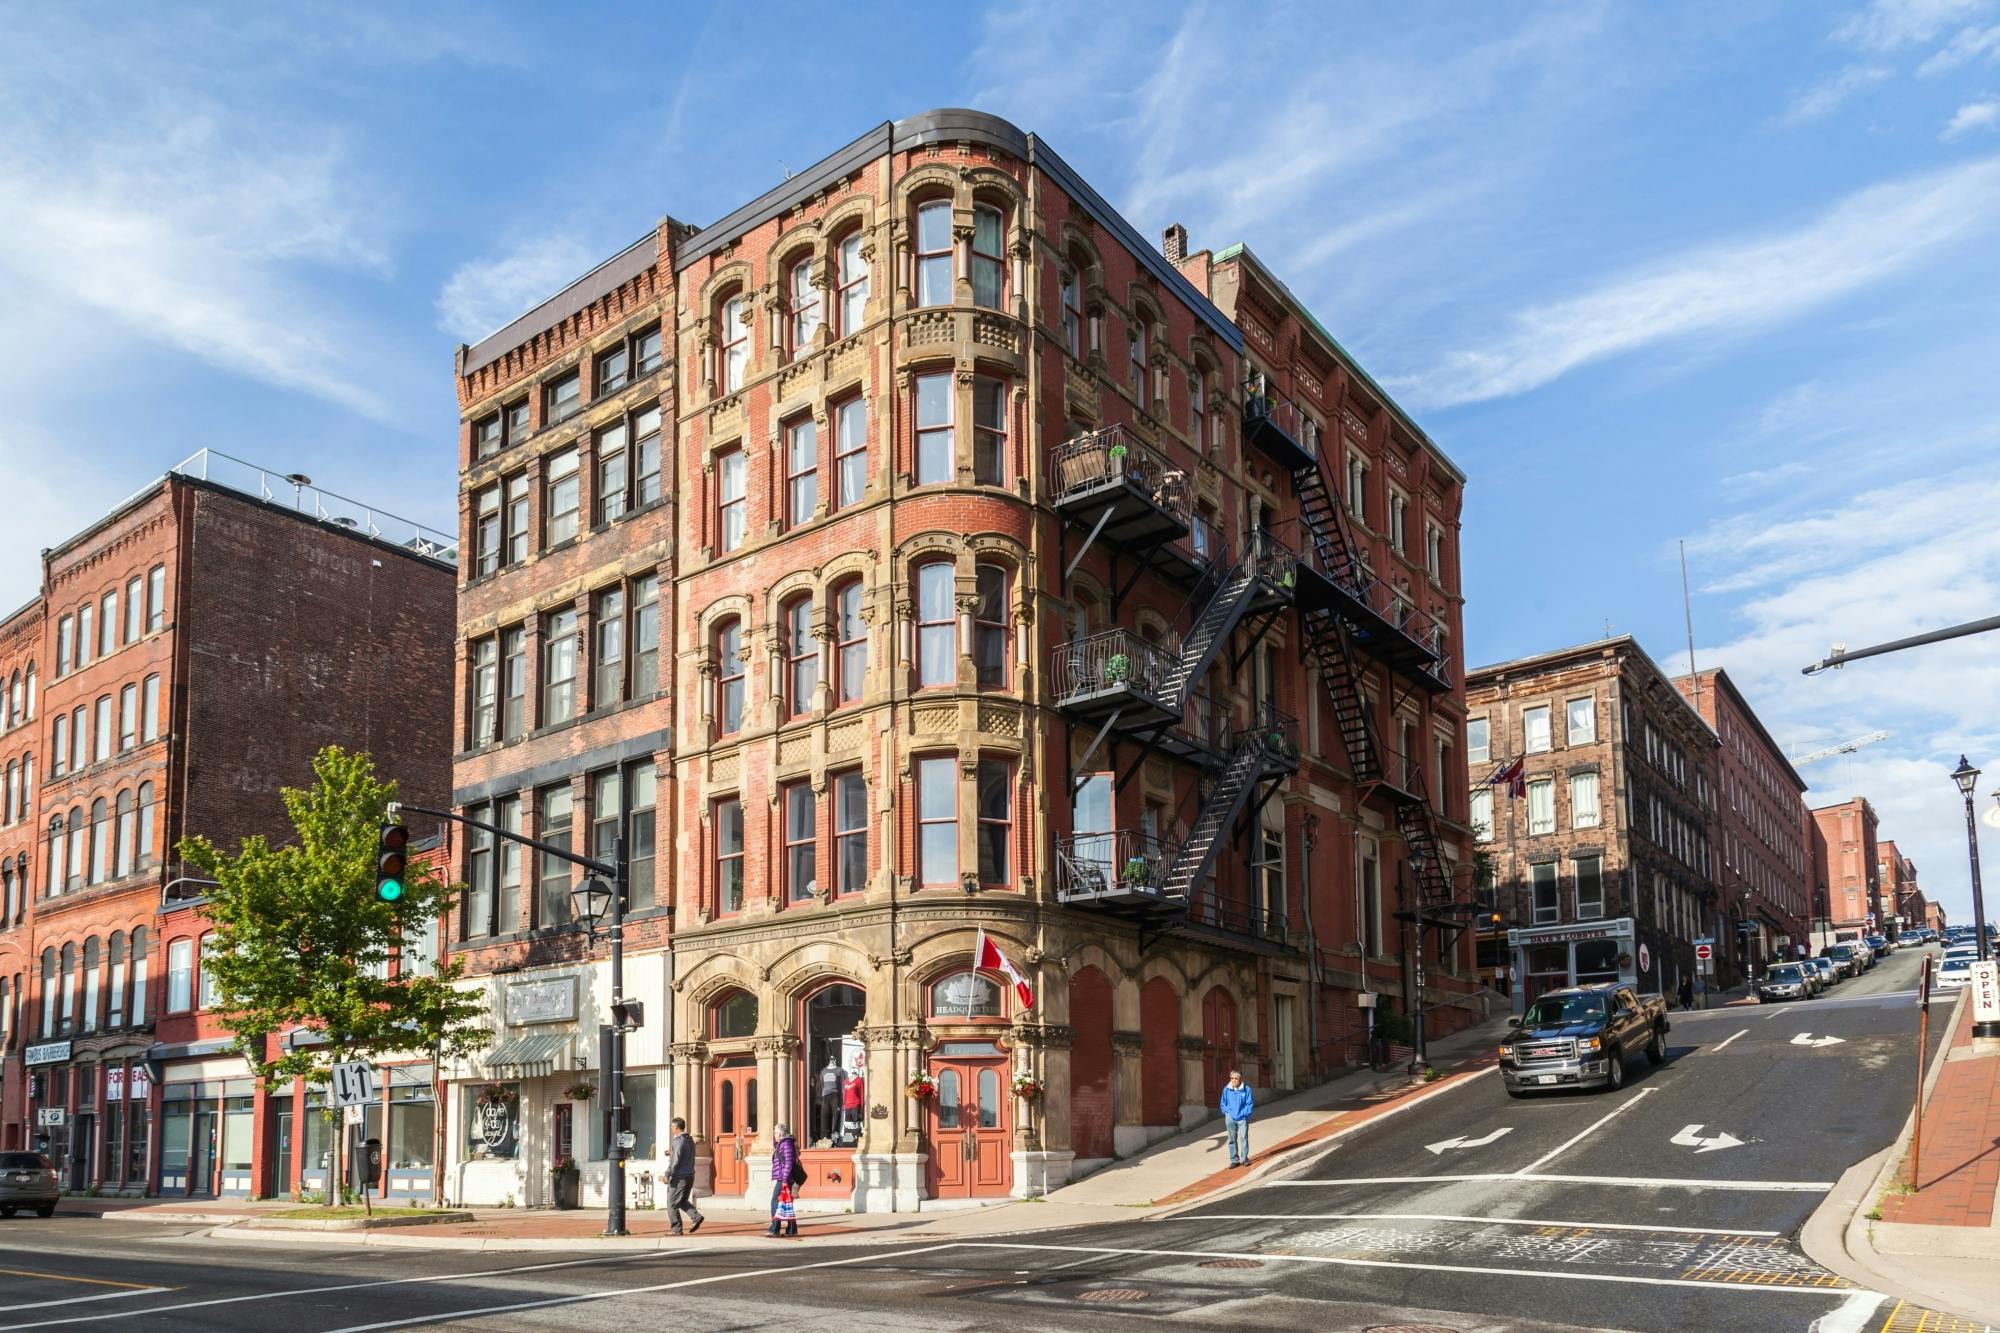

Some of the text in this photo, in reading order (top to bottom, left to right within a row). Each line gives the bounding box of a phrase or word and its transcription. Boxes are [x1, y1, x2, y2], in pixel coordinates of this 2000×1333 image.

[1530, 930, 1607, 943] DAVE'S LOBSTER
[1980, 971, 1992, 1009] OPEN
[109, 1072, 124, 1084] FOR
